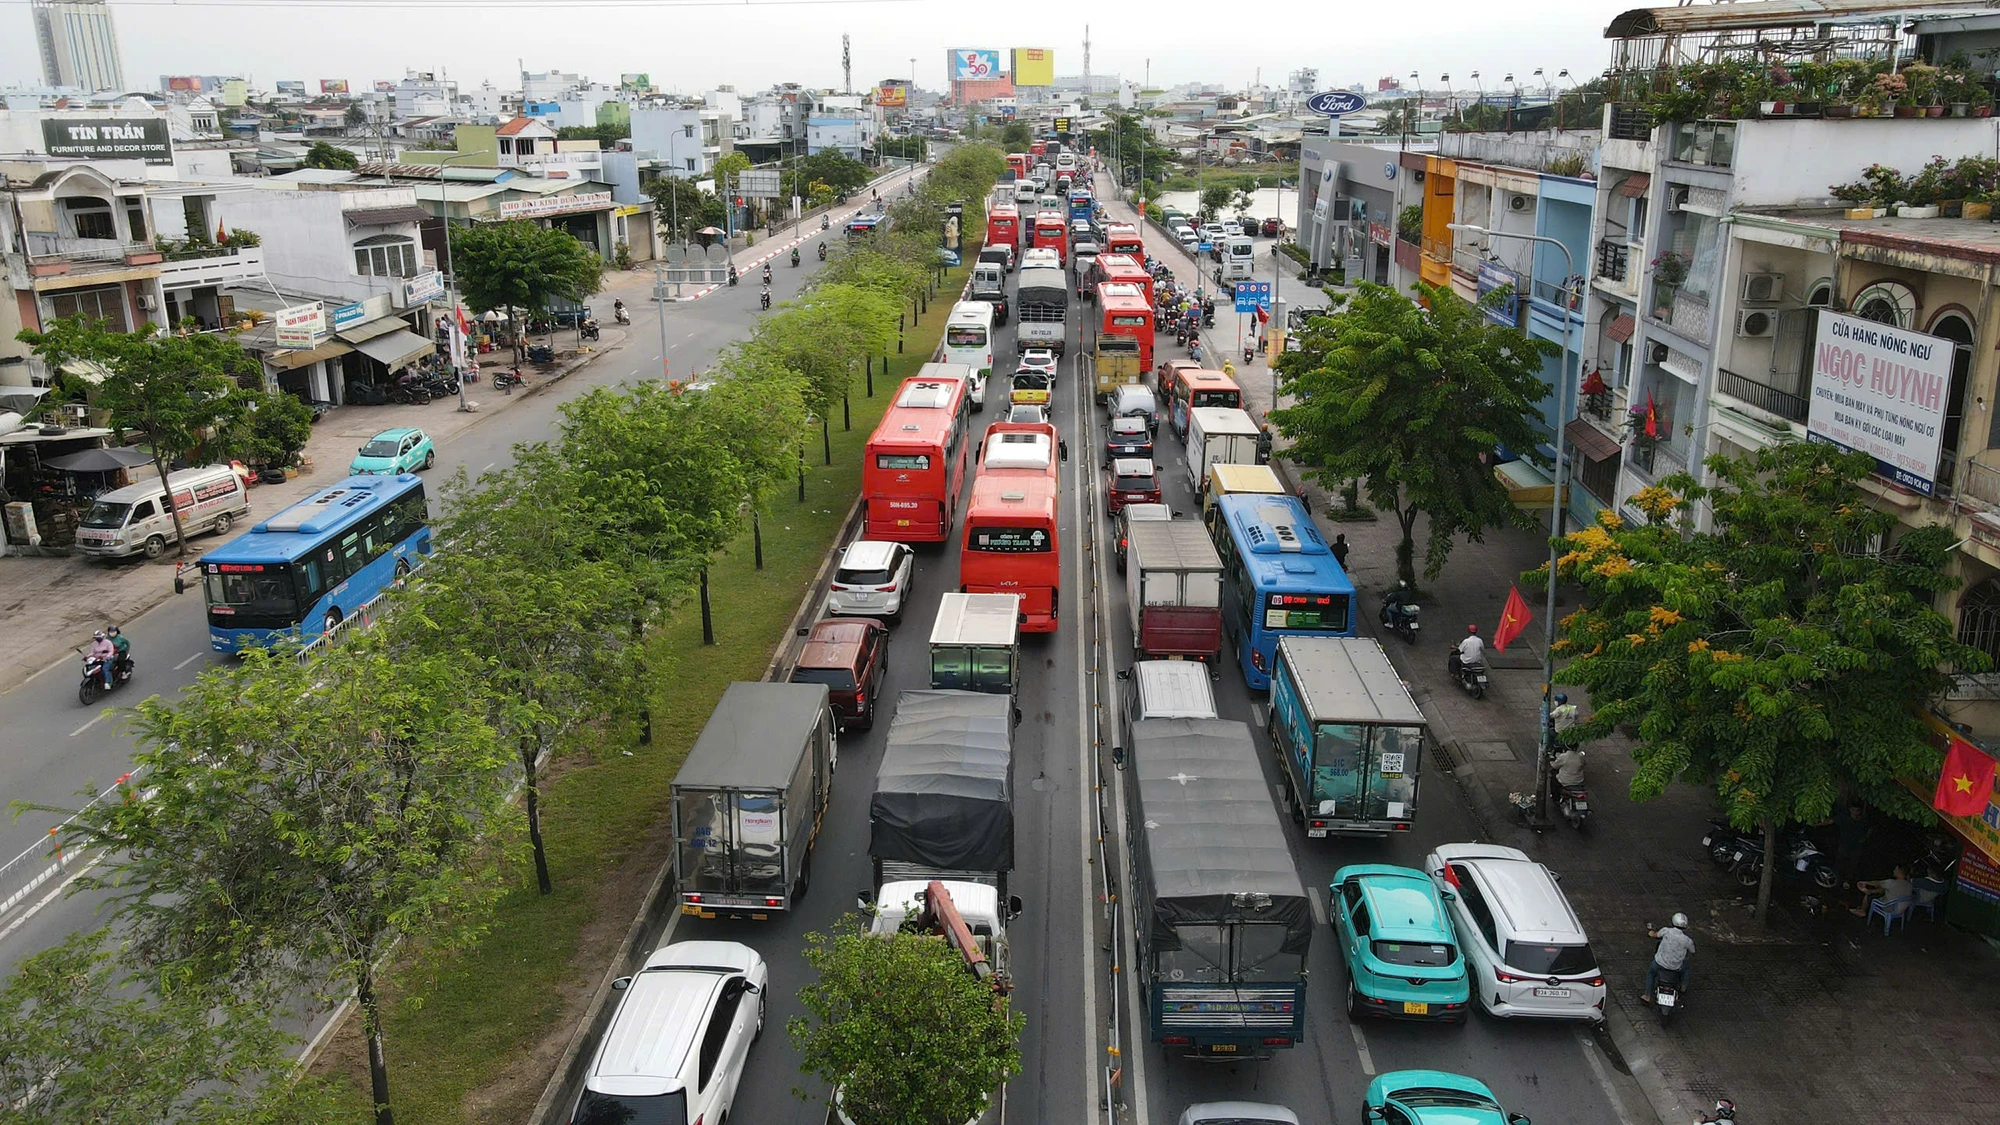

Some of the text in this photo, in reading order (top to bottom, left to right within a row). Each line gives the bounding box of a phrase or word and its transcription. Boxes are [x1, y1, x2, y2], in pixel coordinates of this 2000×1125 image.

[1320, 95, 1354, 110] Ford
[68, 122, 145, 140] TÍN TRẦN
[51, 145, 95, 153] FURNITURE
[1832, 316, 1850, 338] CỬA
[1879, 330, 1907, 354] NÔNG
[1816, 340, 1867, 394] NGỌC
[1273, 596, 1282, 604] 09
[1333, 759, 1344, 767] 51C
